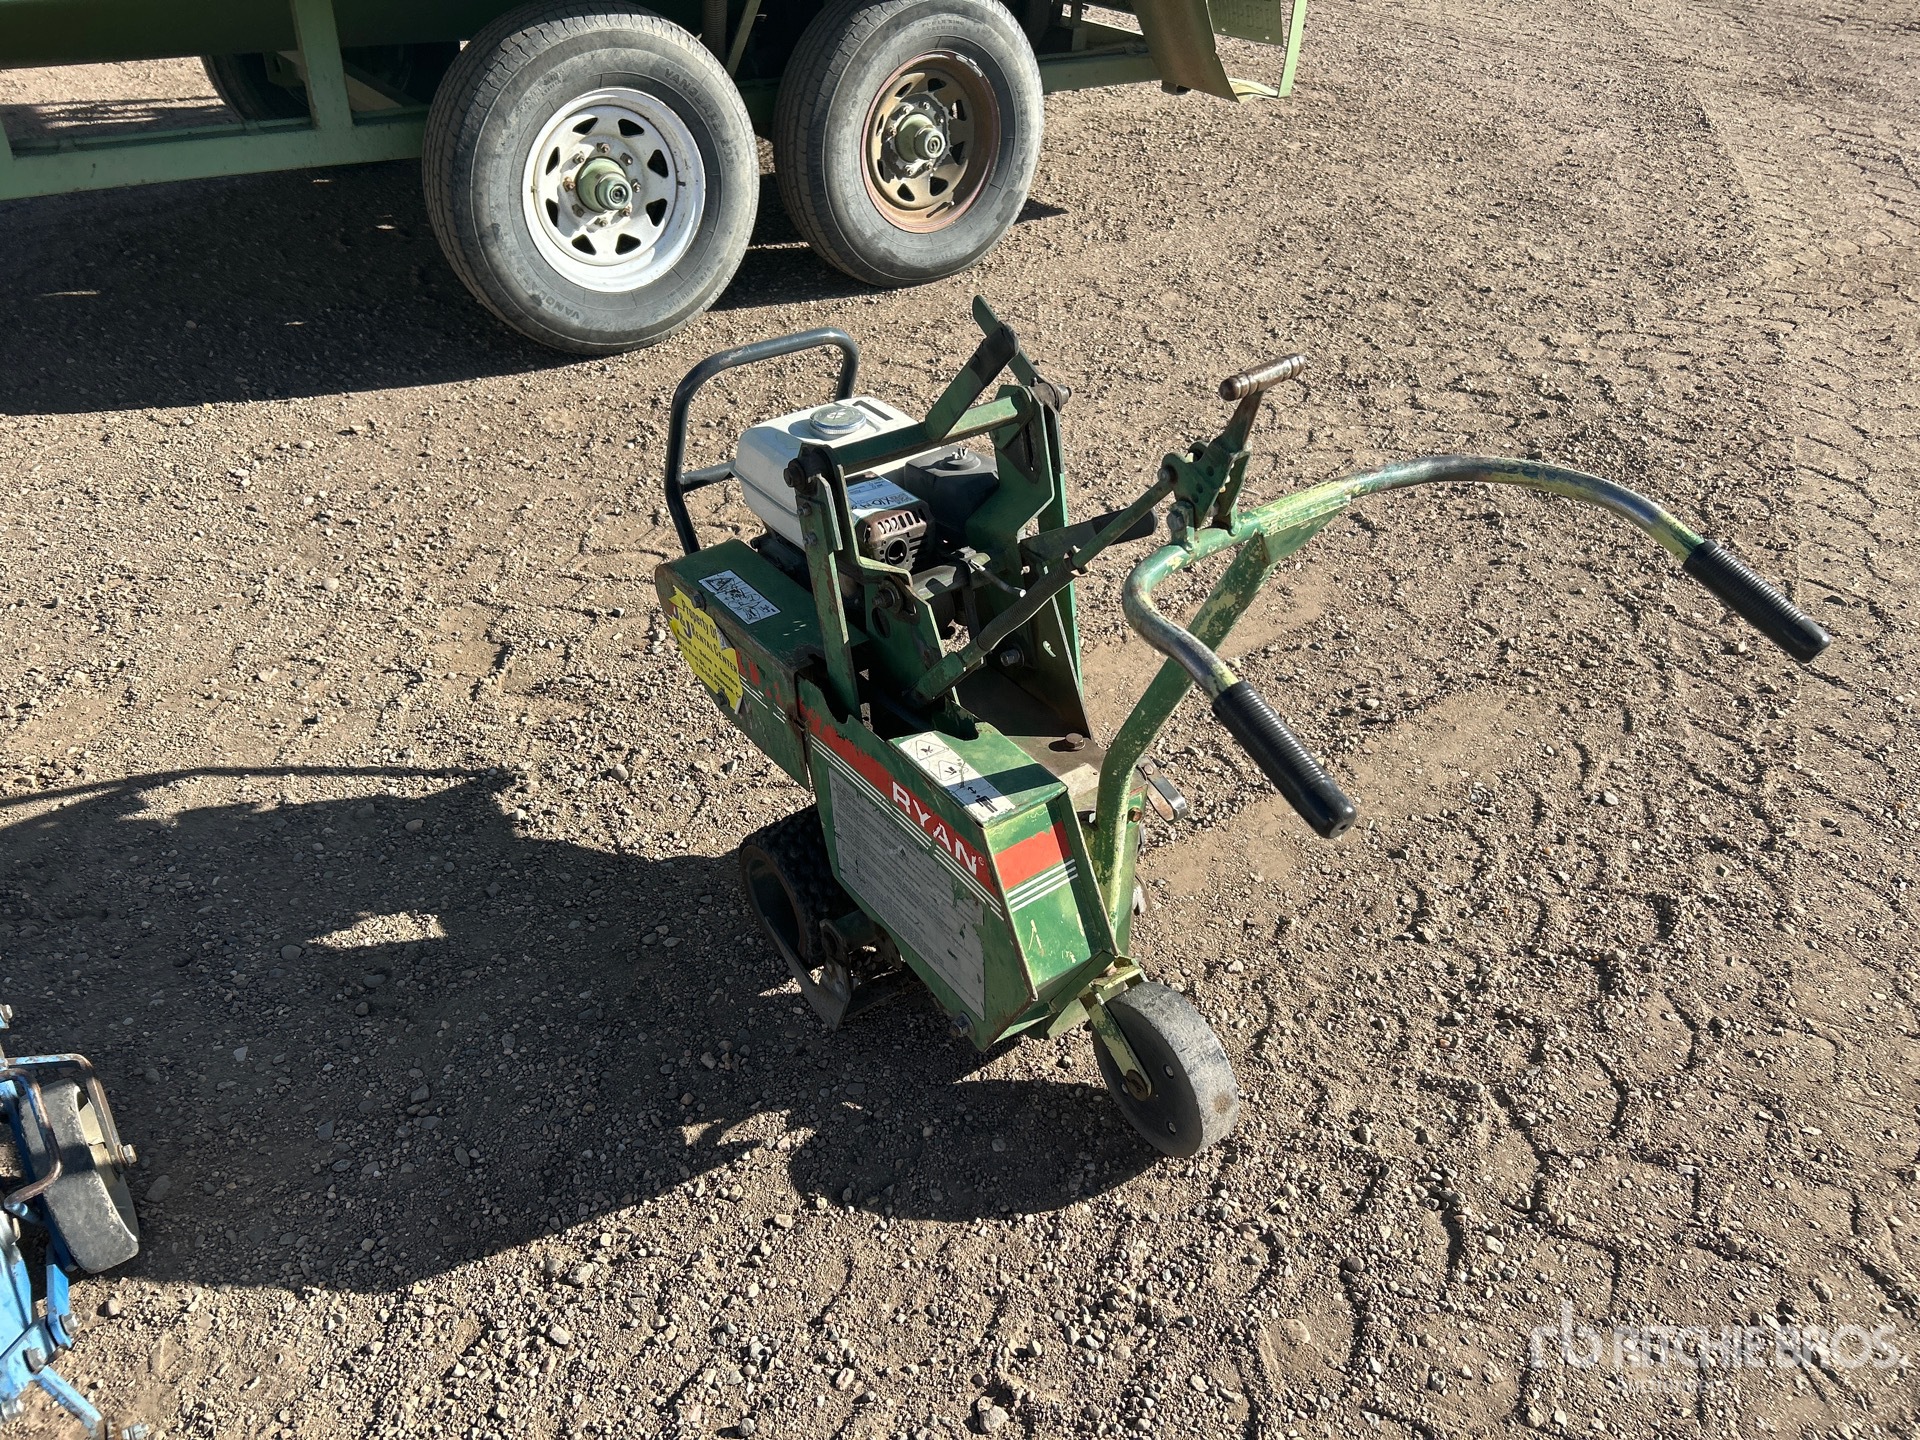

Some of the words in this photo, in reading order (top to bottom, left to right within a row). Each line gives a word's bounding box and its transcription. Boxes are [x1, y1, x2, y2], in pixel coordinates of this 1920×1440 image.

[681, 599, 709, 635] Property
[709, 624, 718, 641] Of
[691, 623, 715, 654] RENTAL
[713, 643, 738, 674] CENTER
